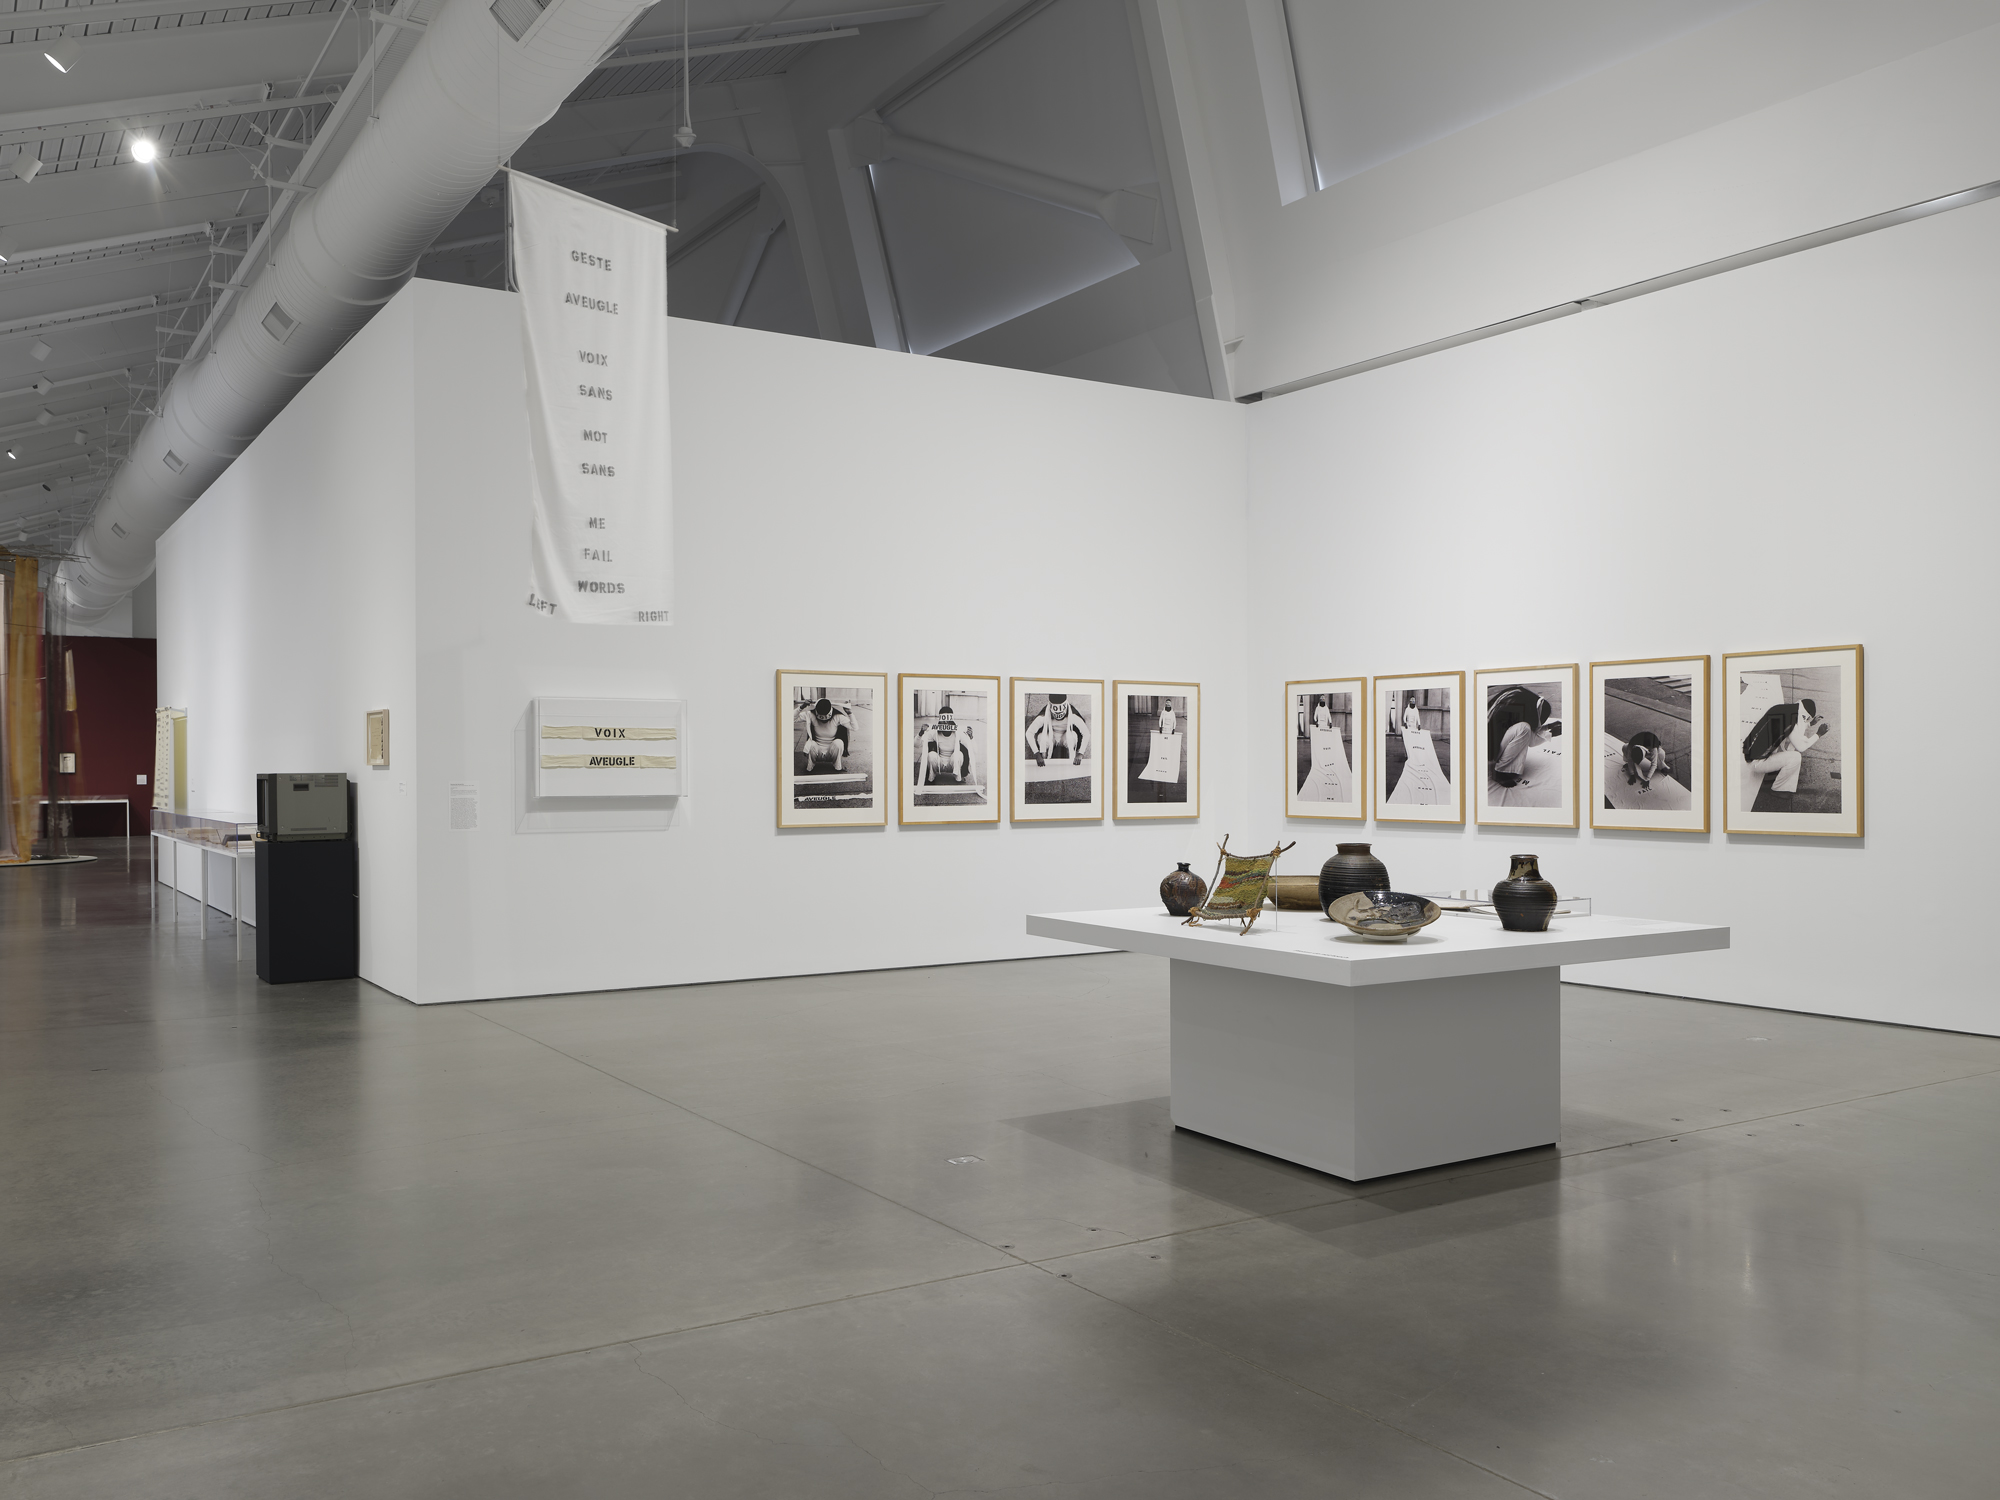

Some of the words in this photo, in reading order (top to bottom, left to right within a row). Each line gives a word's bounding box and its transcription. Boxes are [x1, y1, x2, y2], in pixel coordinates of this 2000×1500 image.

[571, 250, 612, 271] GESTE
[565, 292, 619, 315] AVEUGLE
[579, 350, 608, 367] VOIX
[579, 384, 613, 401] SANS
[583, 429, 608, 444] MOT
[581, 462, 615, 477] SANS
[588, 517, 606, 530] ME
[583, 548, 613, 563] FAIL
[577, 580, 625, 594] WORDS
[528, 593, 558, 615] LEFT
[638, 611, 669, 622] RIGHT
[594, 728, 626, 738] VOIX
[589, 757, 635, 766] AVEUGLE
